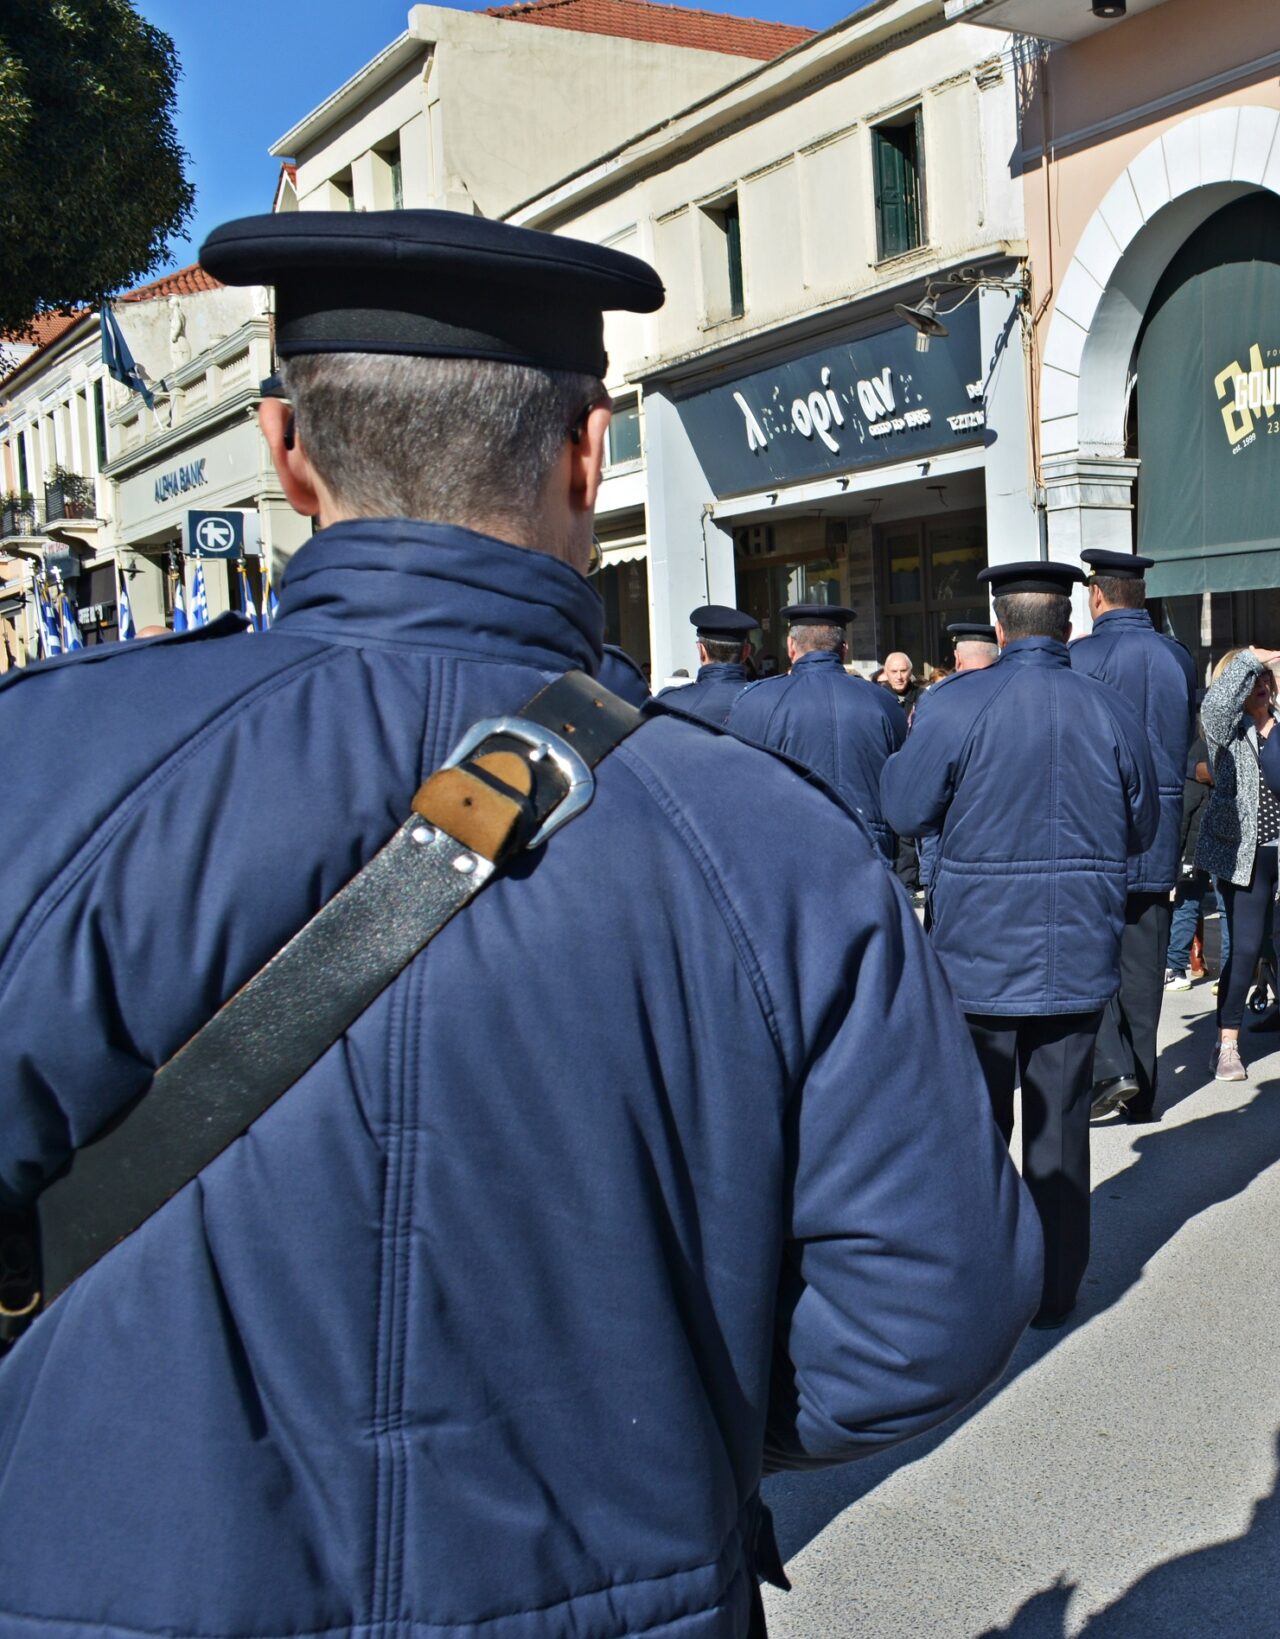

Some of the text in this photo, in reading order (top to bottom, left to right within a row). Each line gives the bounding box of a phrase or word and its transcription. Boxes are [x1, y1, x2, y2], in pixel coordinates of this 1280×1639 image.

[1267, 421, 1280, 434] 23
[155, 459, 206, 501] ALPHA BANK
